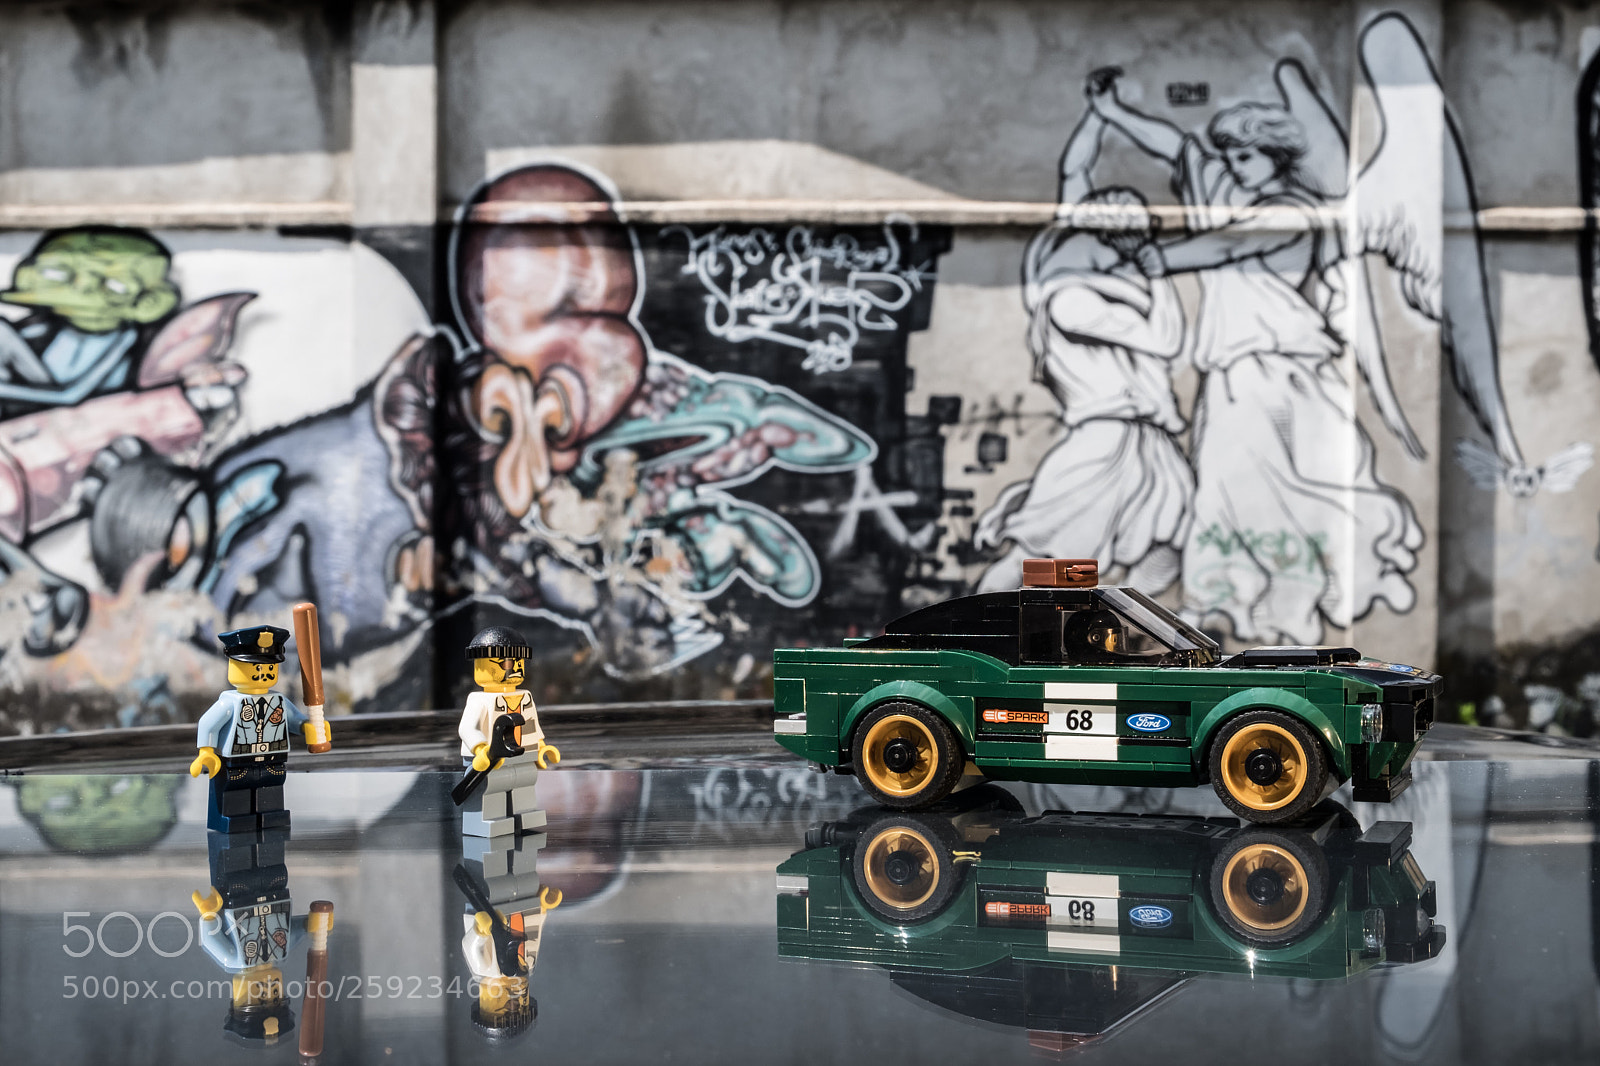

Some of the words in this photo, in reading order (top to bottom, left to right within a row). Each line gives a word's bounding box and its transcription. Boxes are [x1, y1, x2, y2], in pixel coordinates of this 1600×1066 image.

[1007, 712, 1046, 722] SPARK
[1066, 709, 1093, 731] 68
[1135, 715, 1162, 729] Ford
